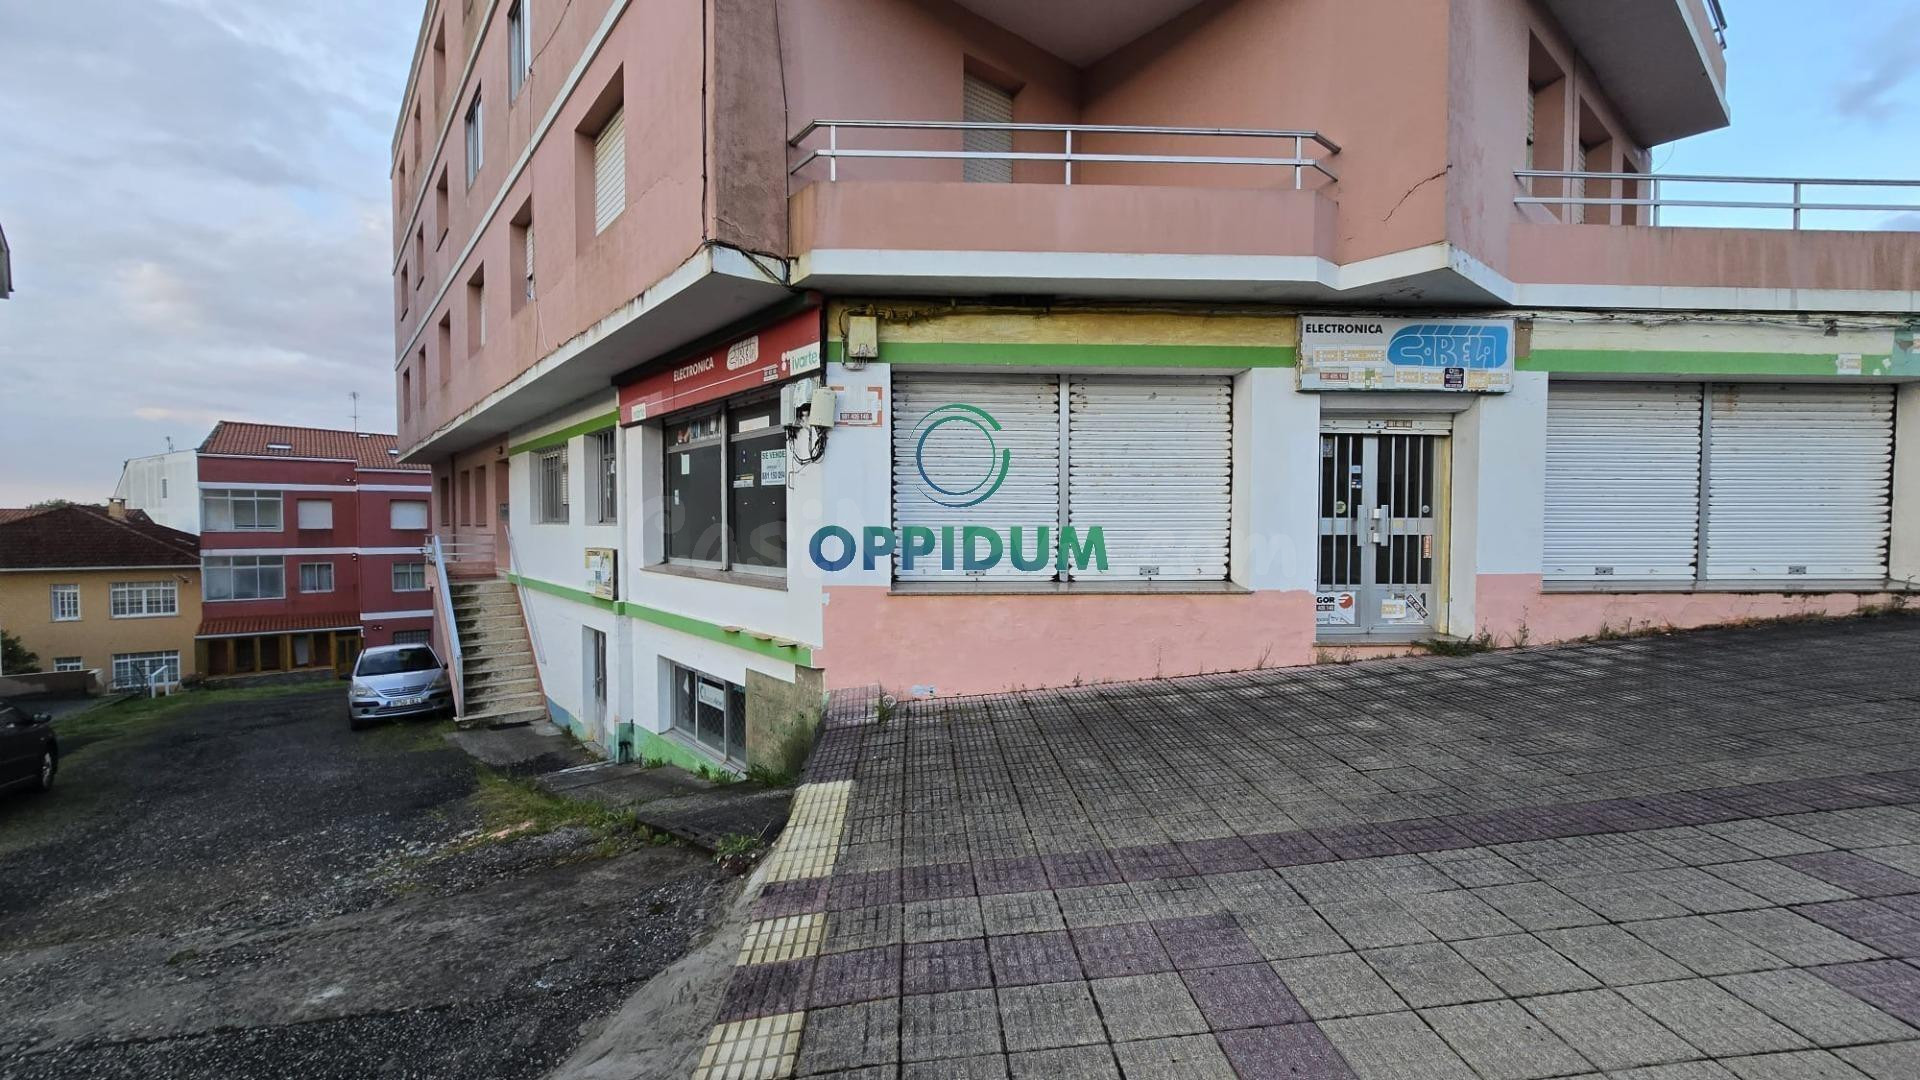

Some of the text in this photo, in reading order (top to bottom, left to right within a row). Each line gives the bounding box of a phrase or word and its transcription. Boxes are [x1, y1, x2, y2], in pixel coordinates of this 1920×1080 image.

[1305, 323, 1383, 334] ELECTRONICA
[673, 356, 714, 382] ELECTRONICA
[762, 450, 787, 460] SE VENDE
